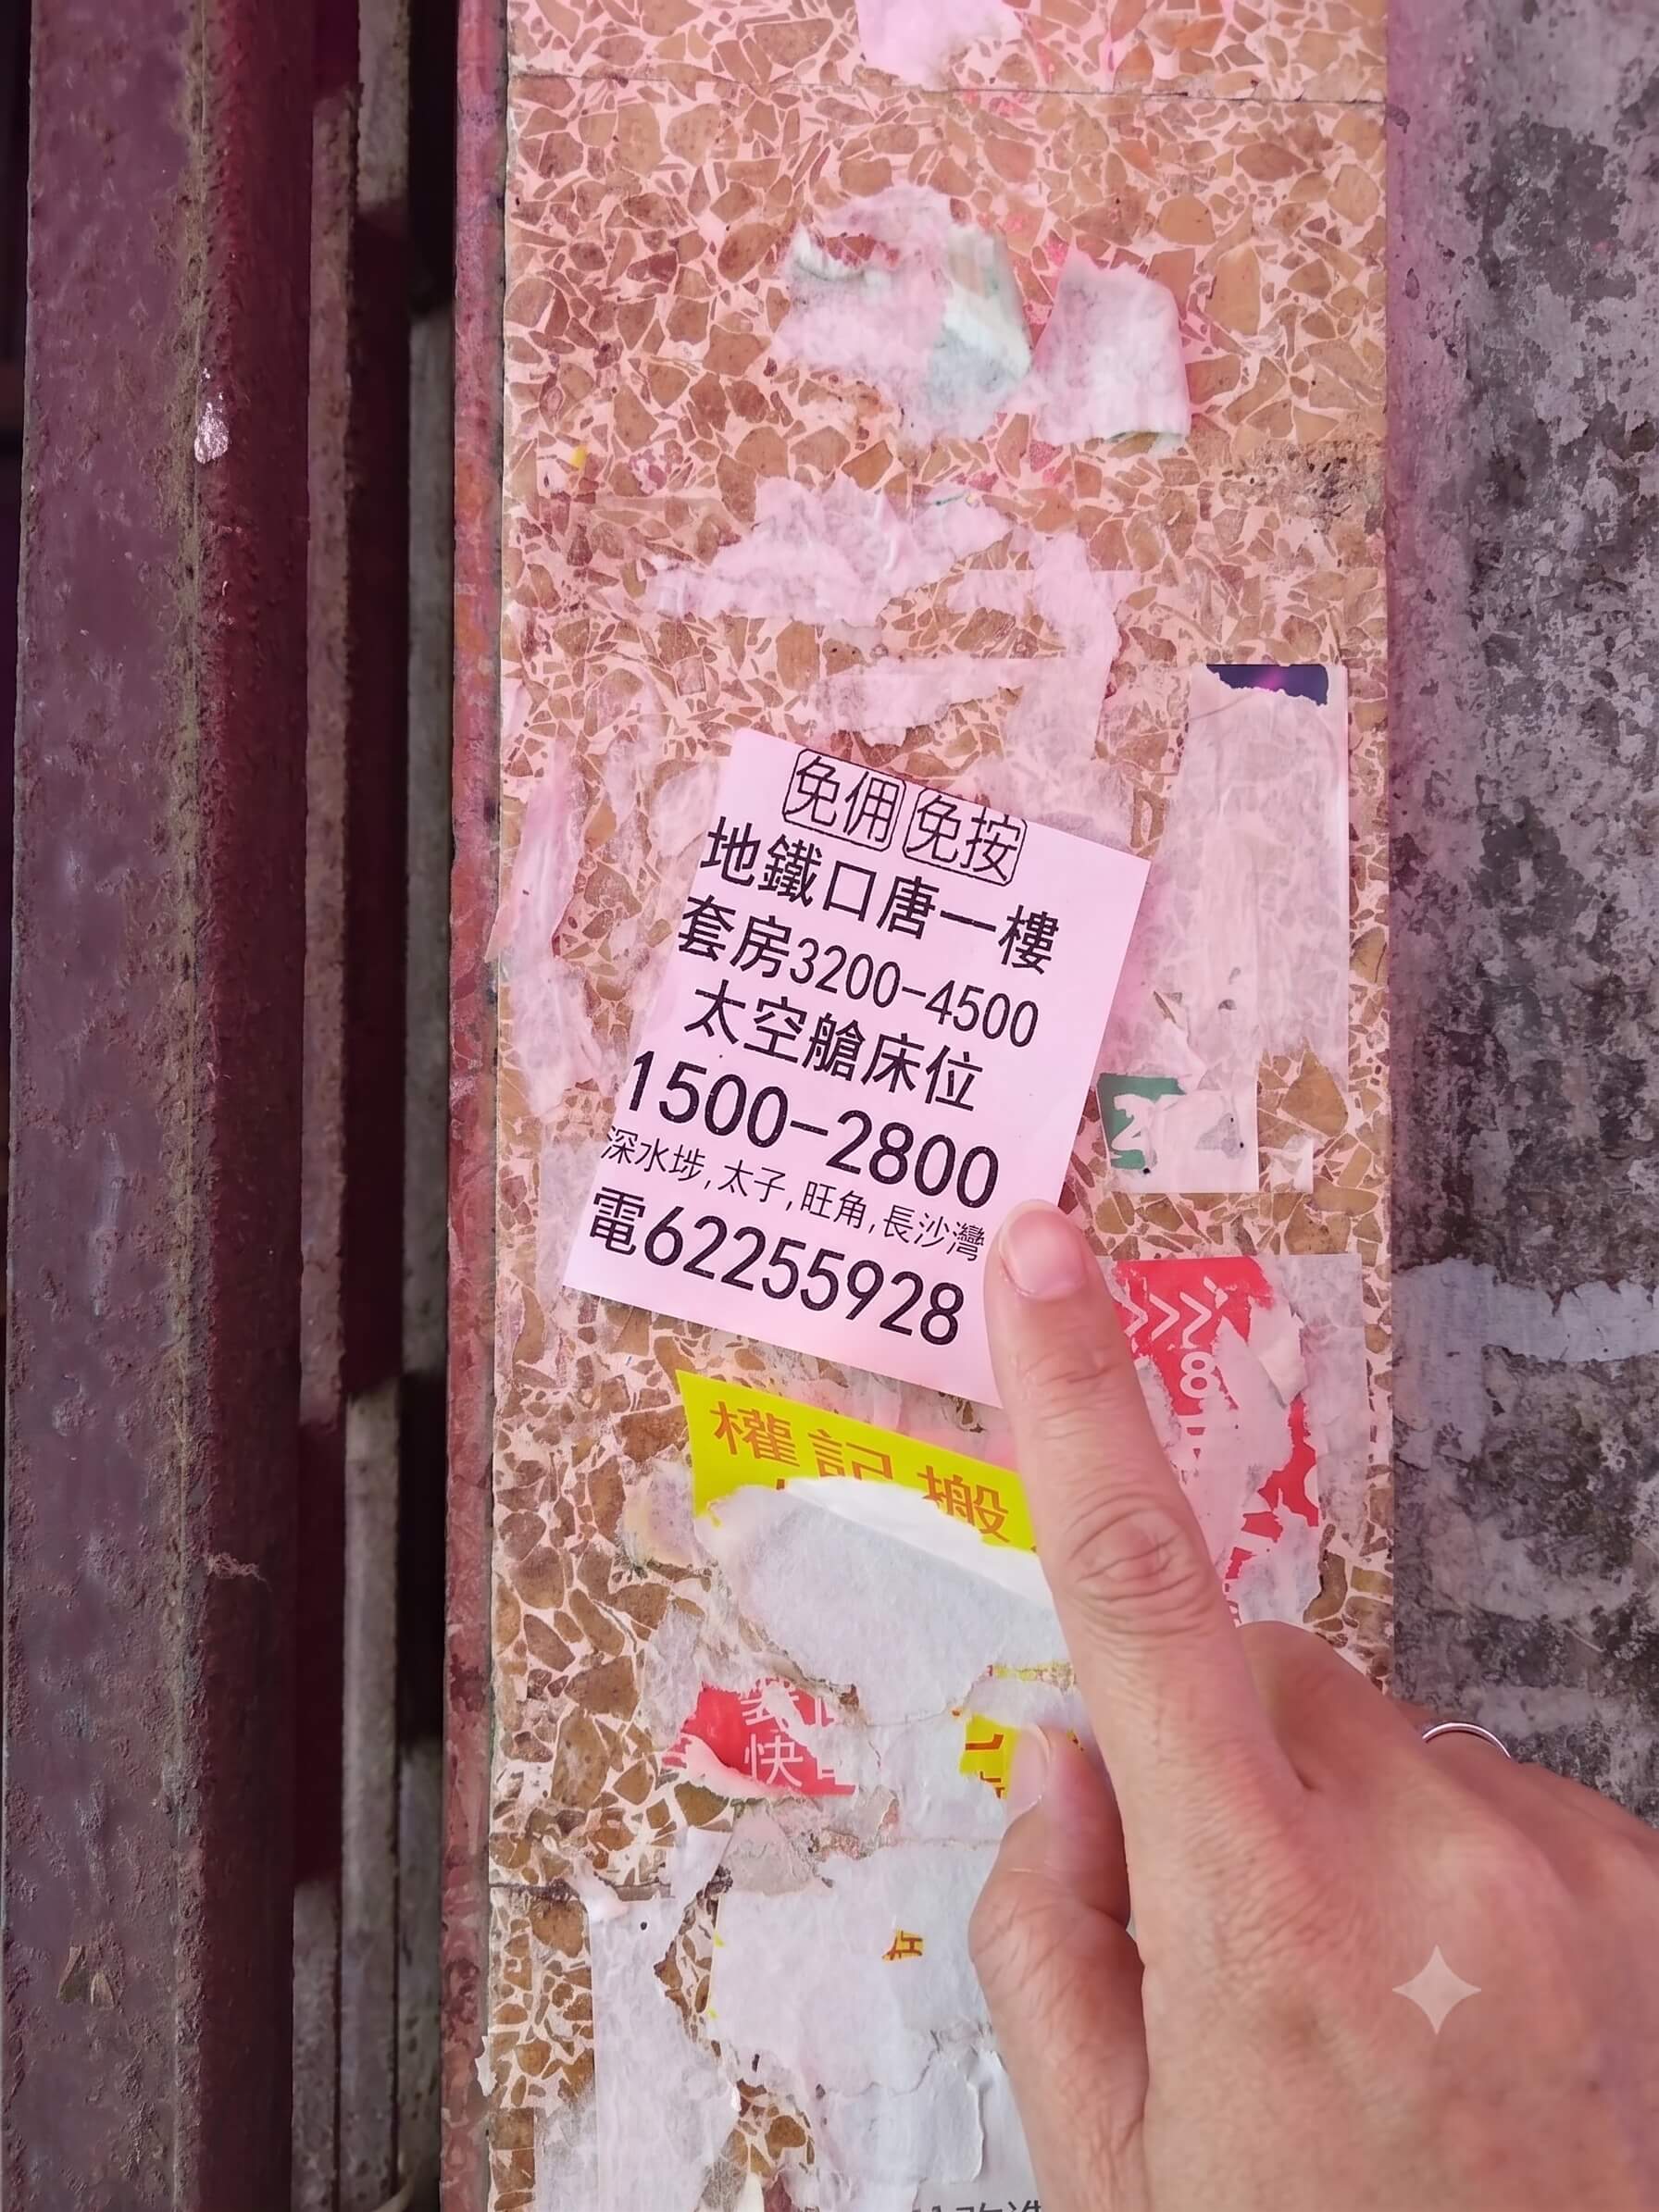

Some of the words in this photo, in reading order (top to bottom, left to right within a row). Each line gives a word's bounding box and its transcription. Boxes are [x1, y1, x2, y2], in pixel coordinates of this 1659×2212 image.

[698, 814, 1060, 976] 地鐵口唐一樓
[784, 754, 902, 845] 免佣
[904, 793, 1022, 883] 免按
[682, 977, 984, 1112] 太空艙床位
[629, 1050, 1000, 1210] 1500-2800
[589, 1185, 966, 1347] 電62255928
